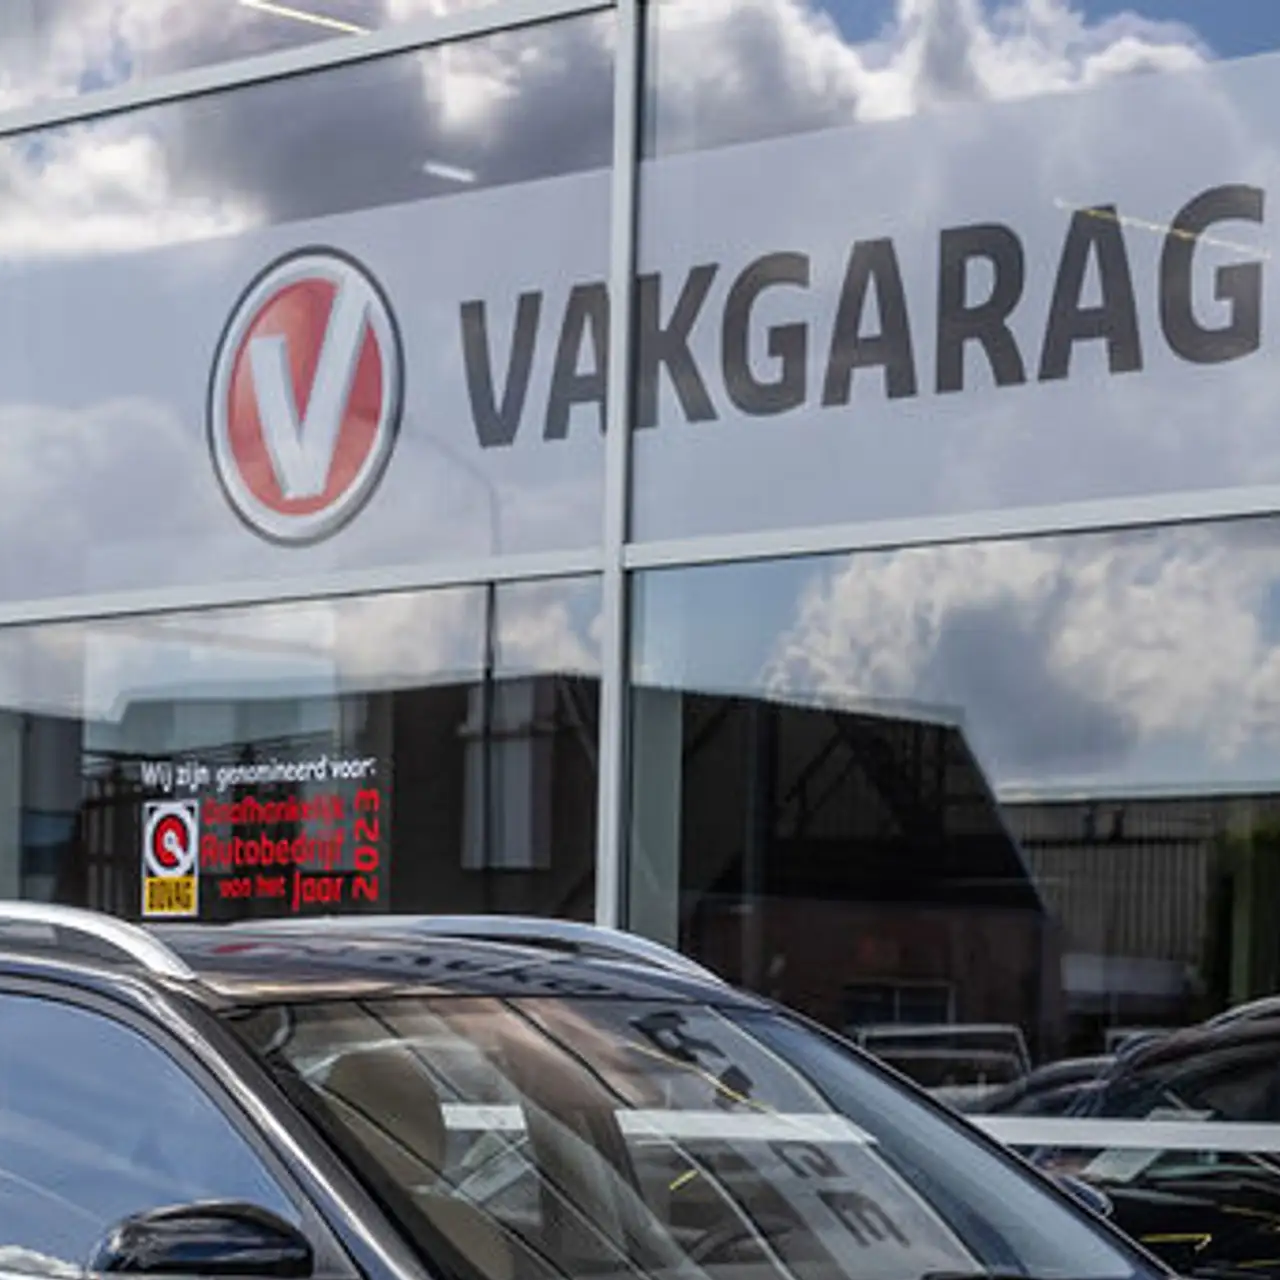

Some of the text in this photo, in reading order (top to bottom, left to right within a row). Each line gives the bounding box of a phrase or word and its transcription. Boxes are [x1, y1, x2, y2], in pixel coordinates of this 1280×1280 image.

[250, 270, 372, 500] V
[140, 761, 173, 793] Wij
[176, 761, 211, 793] zijn
[216, 754, 327, 793] genomineerd
[200, 827, 346, 874] Autobedrijf
[352, 787, 380, 901] 2023
